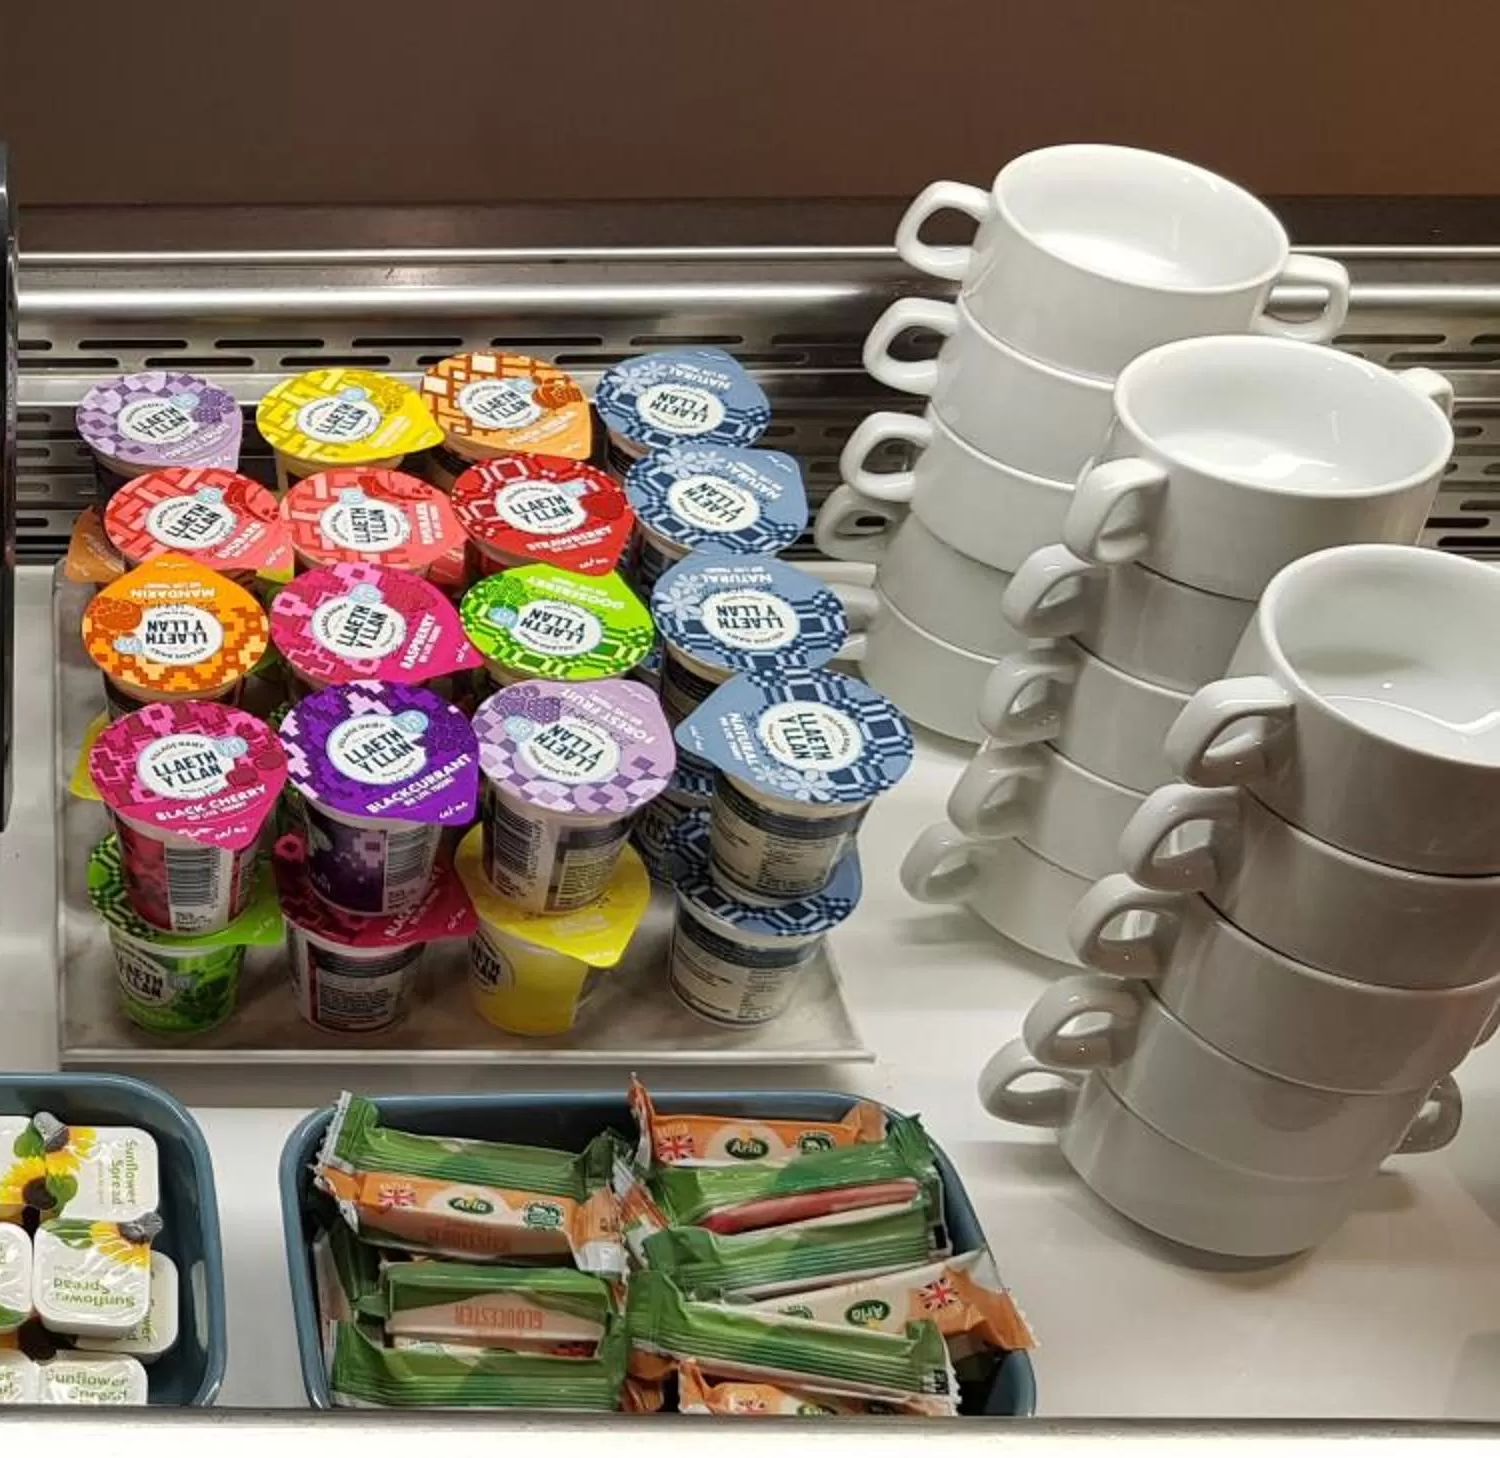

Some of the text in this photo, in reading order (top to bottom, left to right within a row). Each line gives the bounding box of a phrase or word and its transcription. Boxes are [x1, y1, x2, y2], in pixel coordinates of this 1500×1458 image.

[472, 390, 521, 415] LLAETH
[486, 400, 531, 421] Y LLAN
[508, 495, 567, 515] LLAETH
[520, 506, 574, 524] Y LLAN
[164, 503, 210, 537] LLAETH
[180, 512, 222, 541] Y LLAN
[350, 507, 371, 543] LLAETH
[368, 509, 388, 533] LLAN
[699, 573, 773, 584] NATURAL
[131, 588, 216, 599] MANDARIN
[529, 608, 586, 633] Y LLAN
[716, 604, 776, 617] Y LLAN
[147, 620, 204, 633] Y LLAN
[336, 604, 371, 647] LLAETH
[355, 611, 388, 649] Y LLAN
[520, 618, 585, 644] LLAETH
[716, 617, 784, 630] LLAETH
[145, 633, 208, 645] LLAETH
[344, 728, 406, 765] LLAETH
[548, 724, 604, 761] Y LLAN
[778, 713, 812, 760] Y LLAN
[798, 713, 834, 761] LLAETH
[152, 750, 217, 777] LLAETH
[358, 740, 415, 774] Y LLAN
[533, 733, 596, 772] LLAETH
[162, 764, 223, 788] Y LLAN
[365, 753, 472, 813] BLACKCURRANT
[155, 803, 205, 821] BLACK
[208, 784, 266, 809] CHERRY
[731, 1138, 763, 1155] Arla
[111, 1159, 126, 1206] Spread
[125, 1139, 140, 1205] Sunflower
[453, 1199, 487, 1213] Arla
[54, 1278, 111, 1294] Spread
[55, 1292, 136, 1307] Sunflower
[851, 1304, 885, 1323] Arla
